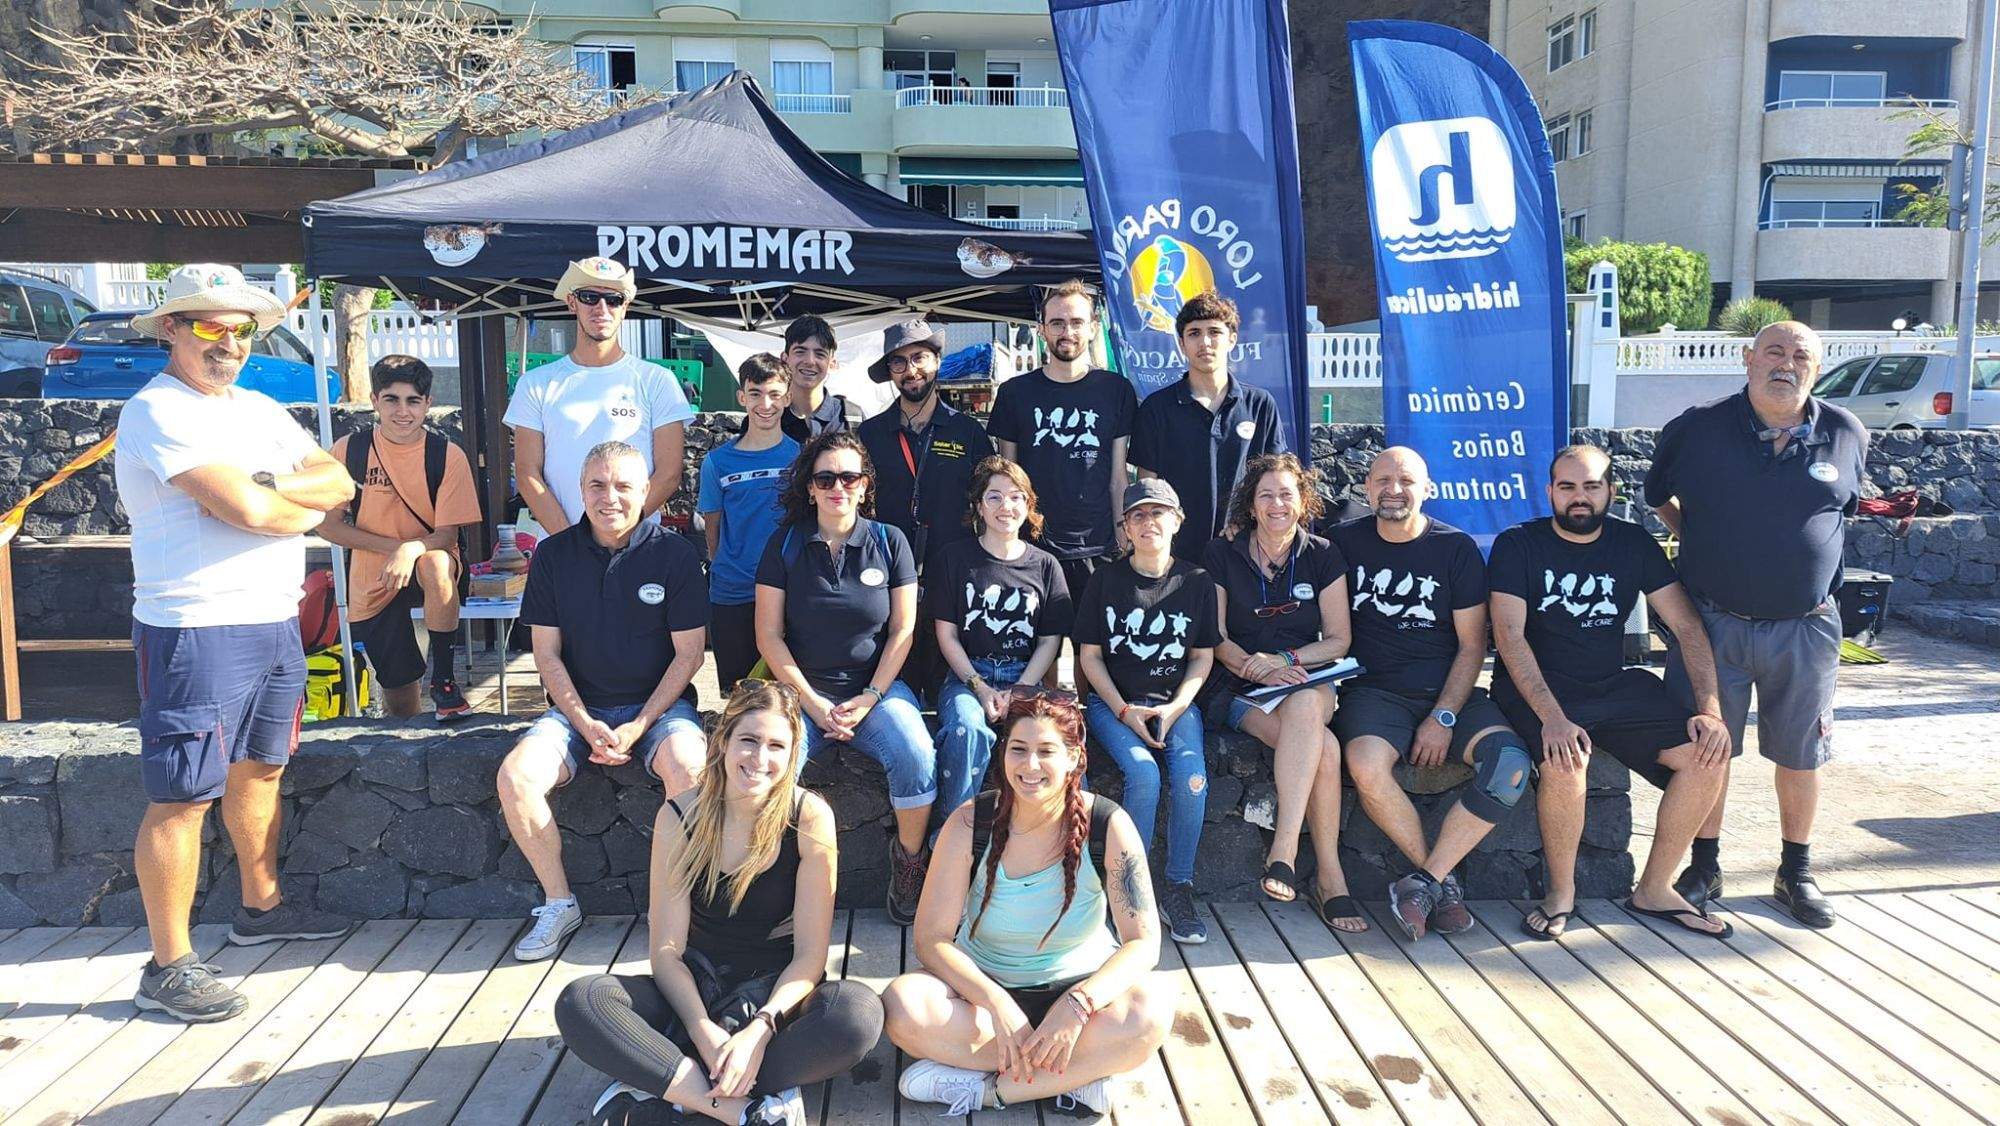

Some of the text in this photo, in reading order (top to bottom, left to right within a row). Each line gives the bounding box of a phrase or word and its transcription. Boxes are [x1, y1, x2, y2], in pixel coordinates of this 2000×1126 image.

[596, 225, 856, 276] PROMEMAR
[611, 408, 636, 418] SOS
[1581, 620, 1593, 628] WE
